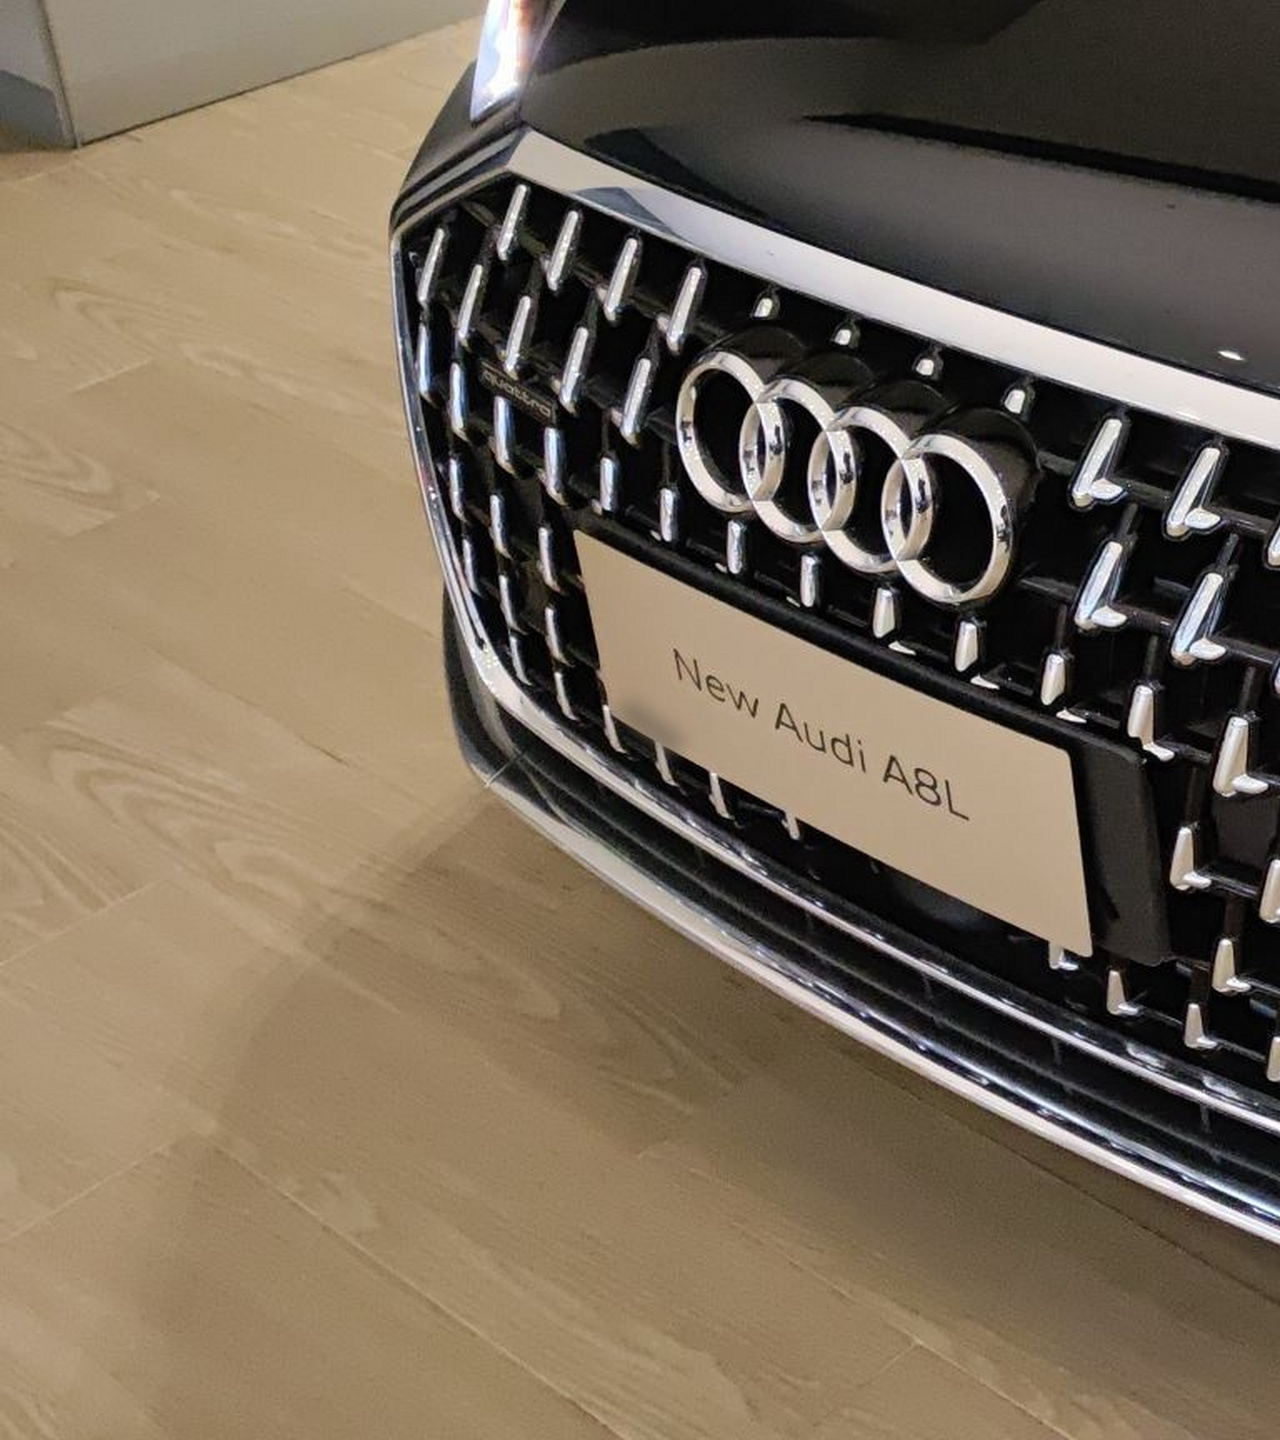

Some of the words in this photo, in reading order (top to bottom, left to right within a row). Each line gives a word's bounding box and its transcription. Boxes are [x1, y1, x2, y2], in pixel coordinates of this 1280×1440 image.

[672, 648, 759, 719] New
[775, 702, 867, 773] Audi
[882, 754, 970, 821] A8L
